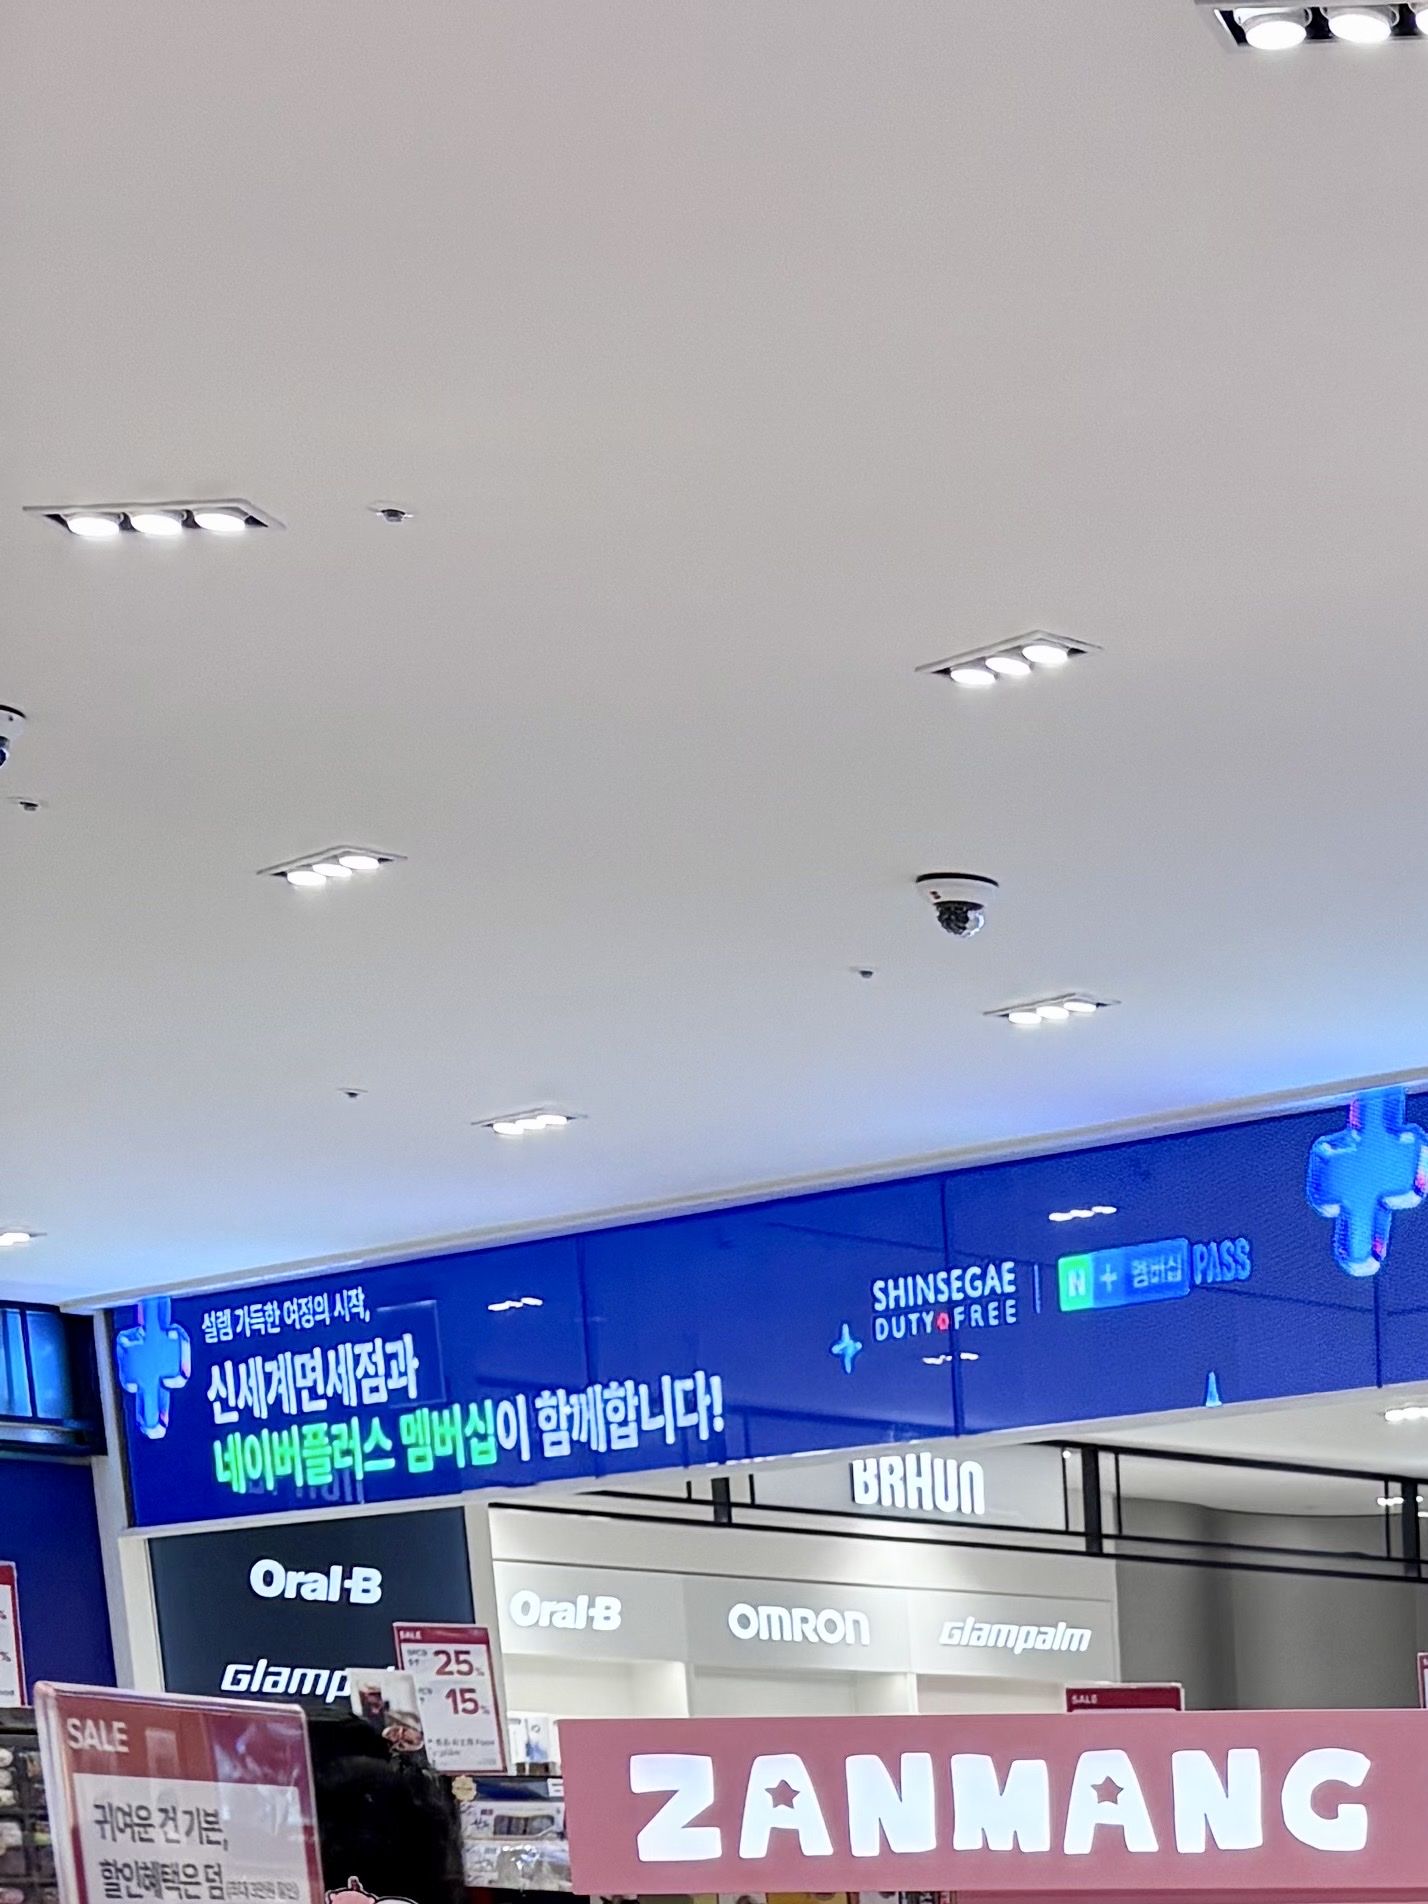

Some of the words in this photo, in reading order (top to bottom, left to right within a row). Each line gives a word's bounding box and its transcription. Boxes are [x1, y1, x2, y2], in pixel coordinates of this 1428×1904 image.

[1192, 1236, 1253, 1284] PASS
[872, 1260, 1018, 1312] SHINSEGAE
[201, 1308, 233, 1342] 설렘
[235, 1301, 281, 1338] 가득한
[283, 1292, 331, 1333] 여정의
[333, 1286, 371, 1325] 시작,
[873, 1310, 934, 1342] DUTY
[953, 1299, 1018, 1331] FREE
[206, 1332, 420, 1427] 신세계면세점과
[212, 1414, 397, 1496] 네이버플러스
[400, 1391, 530, 1477] 멤버십이
[534, 1368, 725, 1458] 함께합니다!
[850, 1452, 986, 1515] BRAUN
[249, 1558, 383, 1605] Oral-B
[509, 1589, 622, 1632] Oral-B
[727, 1602, 871, 1646] OMRON
[939, 1615, 1092, 1656] Glampalm
[220, 1658, 350, 1706] Glamp
[65, 1714, 131, 1756] SALE
[93, 1801, 156, 1844] 귀여운
[157, 1804, 182, 1844] 건
[629, 1743, 1373, 1862] ZANMANG
[98, 1858, 203, 1901] 할인혜택은
[203, 1861, 226, 1901] 덤
